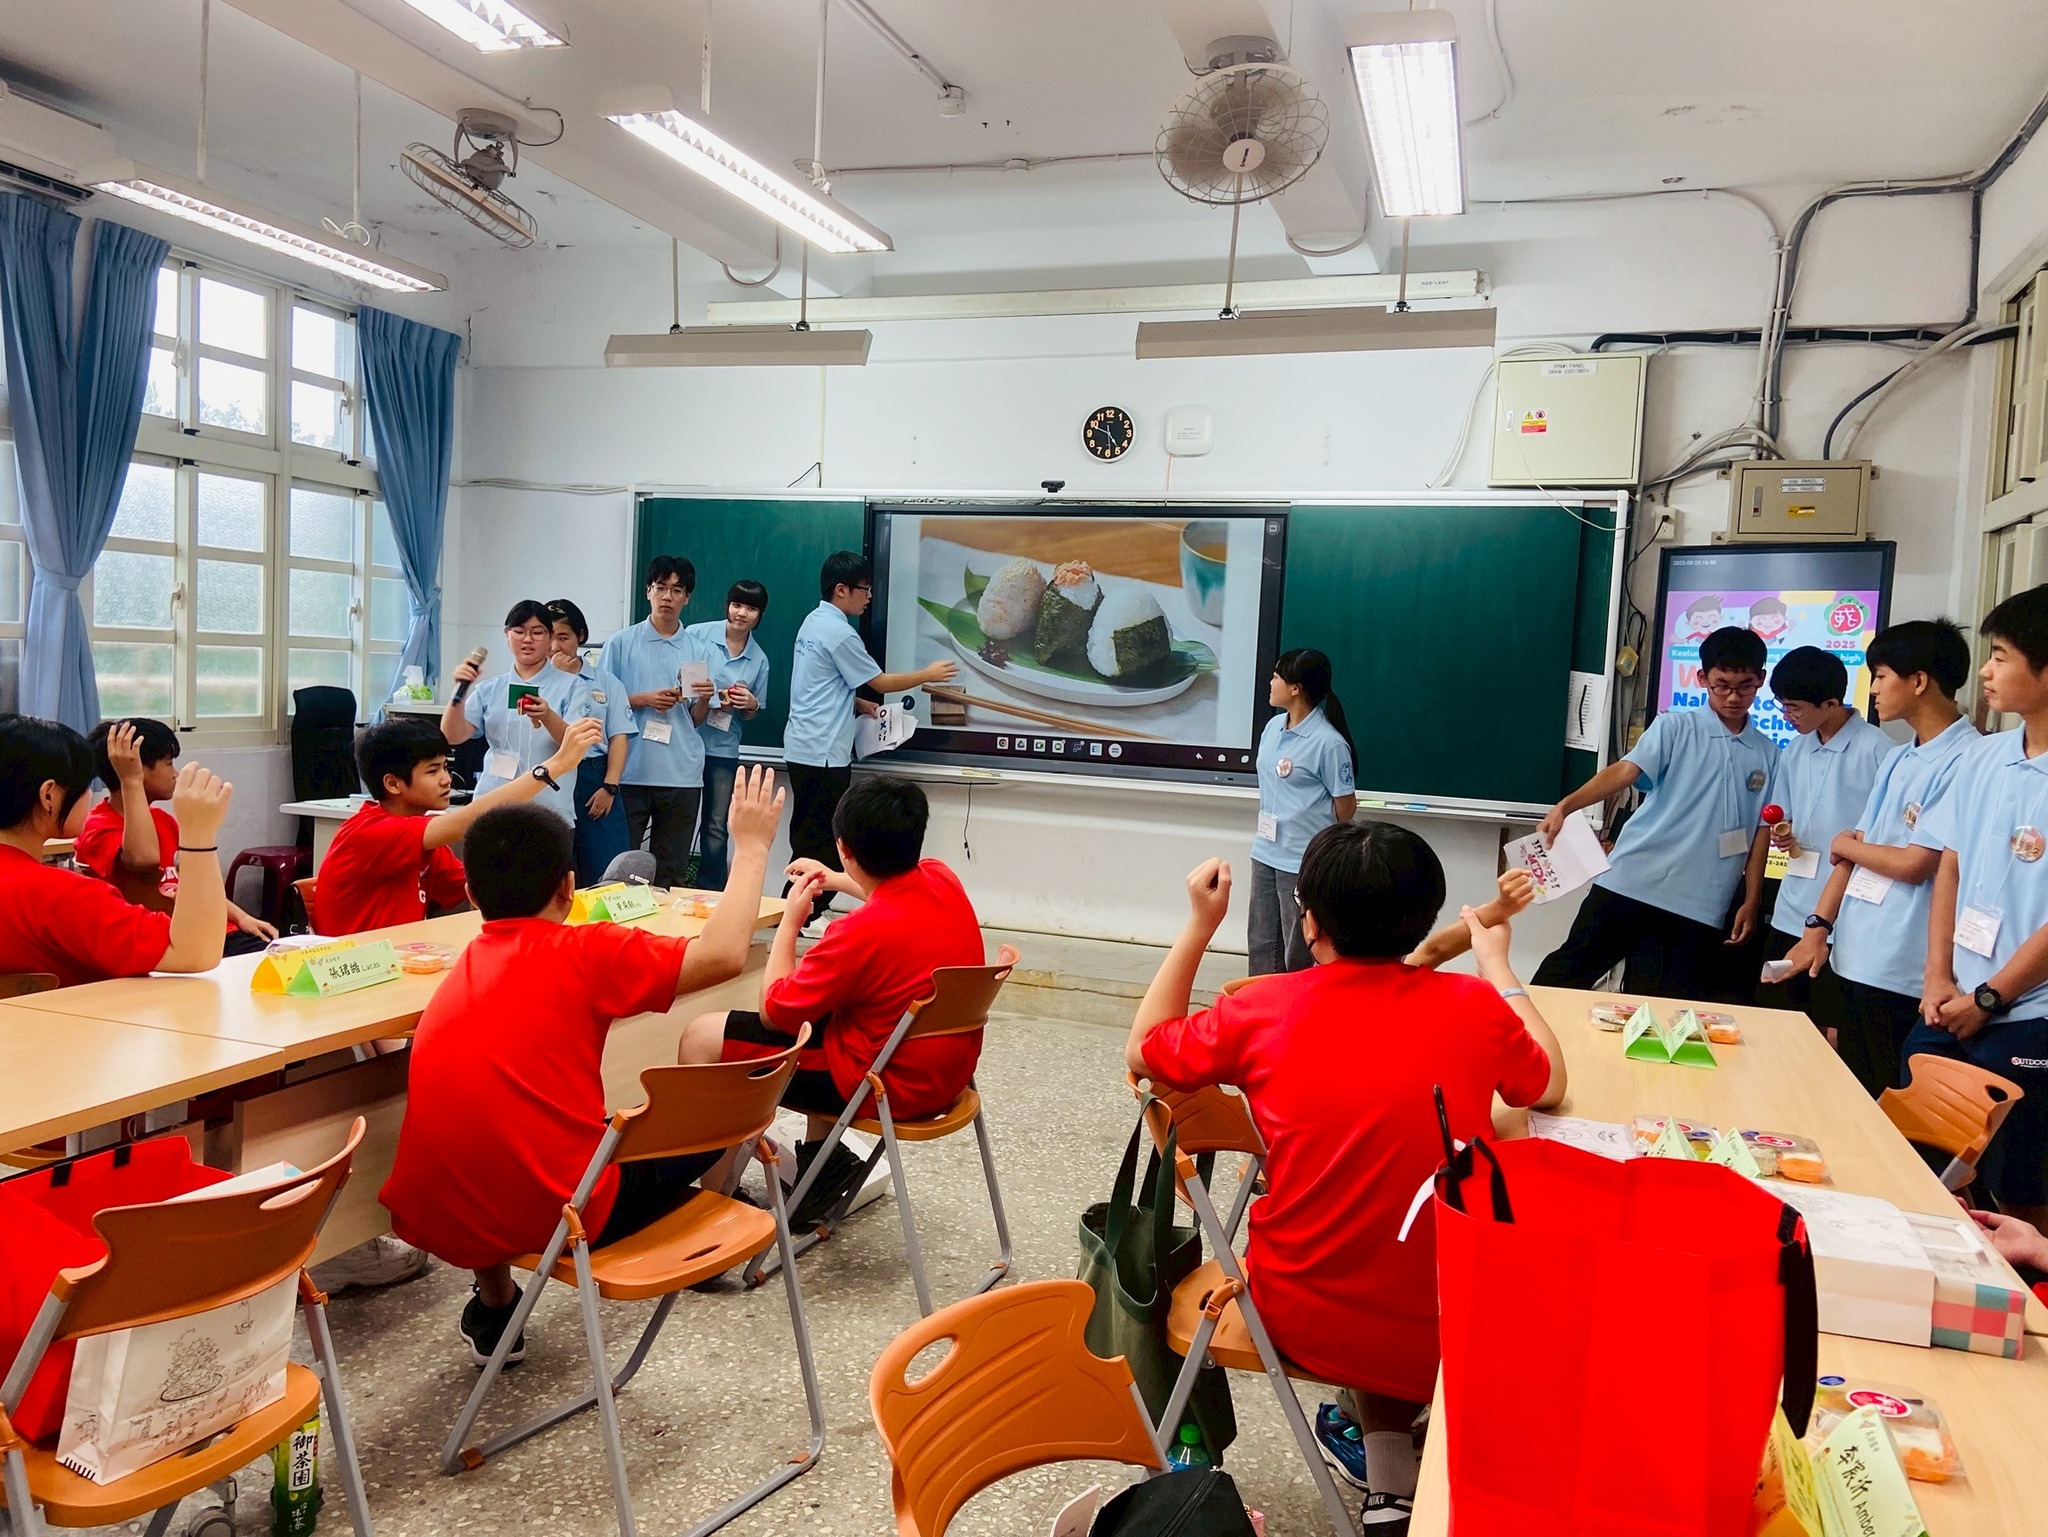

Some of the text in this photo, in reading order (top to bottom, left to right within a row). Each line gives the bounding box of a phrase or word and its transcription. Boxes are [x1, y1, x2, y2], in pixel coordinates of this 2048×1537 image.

[1096, 413, 1105, 421] 11
[1105, 409, 1115, 418] 12
[1118, 413, 1123, 421] 1
[1090, 420, 1099, 428] 10
[1124, 420, 1130, 428] 2
[1086, 430, 1093, 438] 9
[1126, 430, 1132, 438] 3
[1089, 439, 1095, 448] 8
[1122, 440, 1128, 448] 4
[1096, 447, 1102, 455] 7
[1104, 449, 1111, 457] 6
[1114, 447, 1121, 455] 5
[1825, 640, 1856, 649] 2025
[1840, 653, 1861, 664] high
[292, 1434, 314, 1488] 御茶園
[1367, 1494, 1386, 1507] NIKE
[1853, 1500, 1876, 1537] Amber
